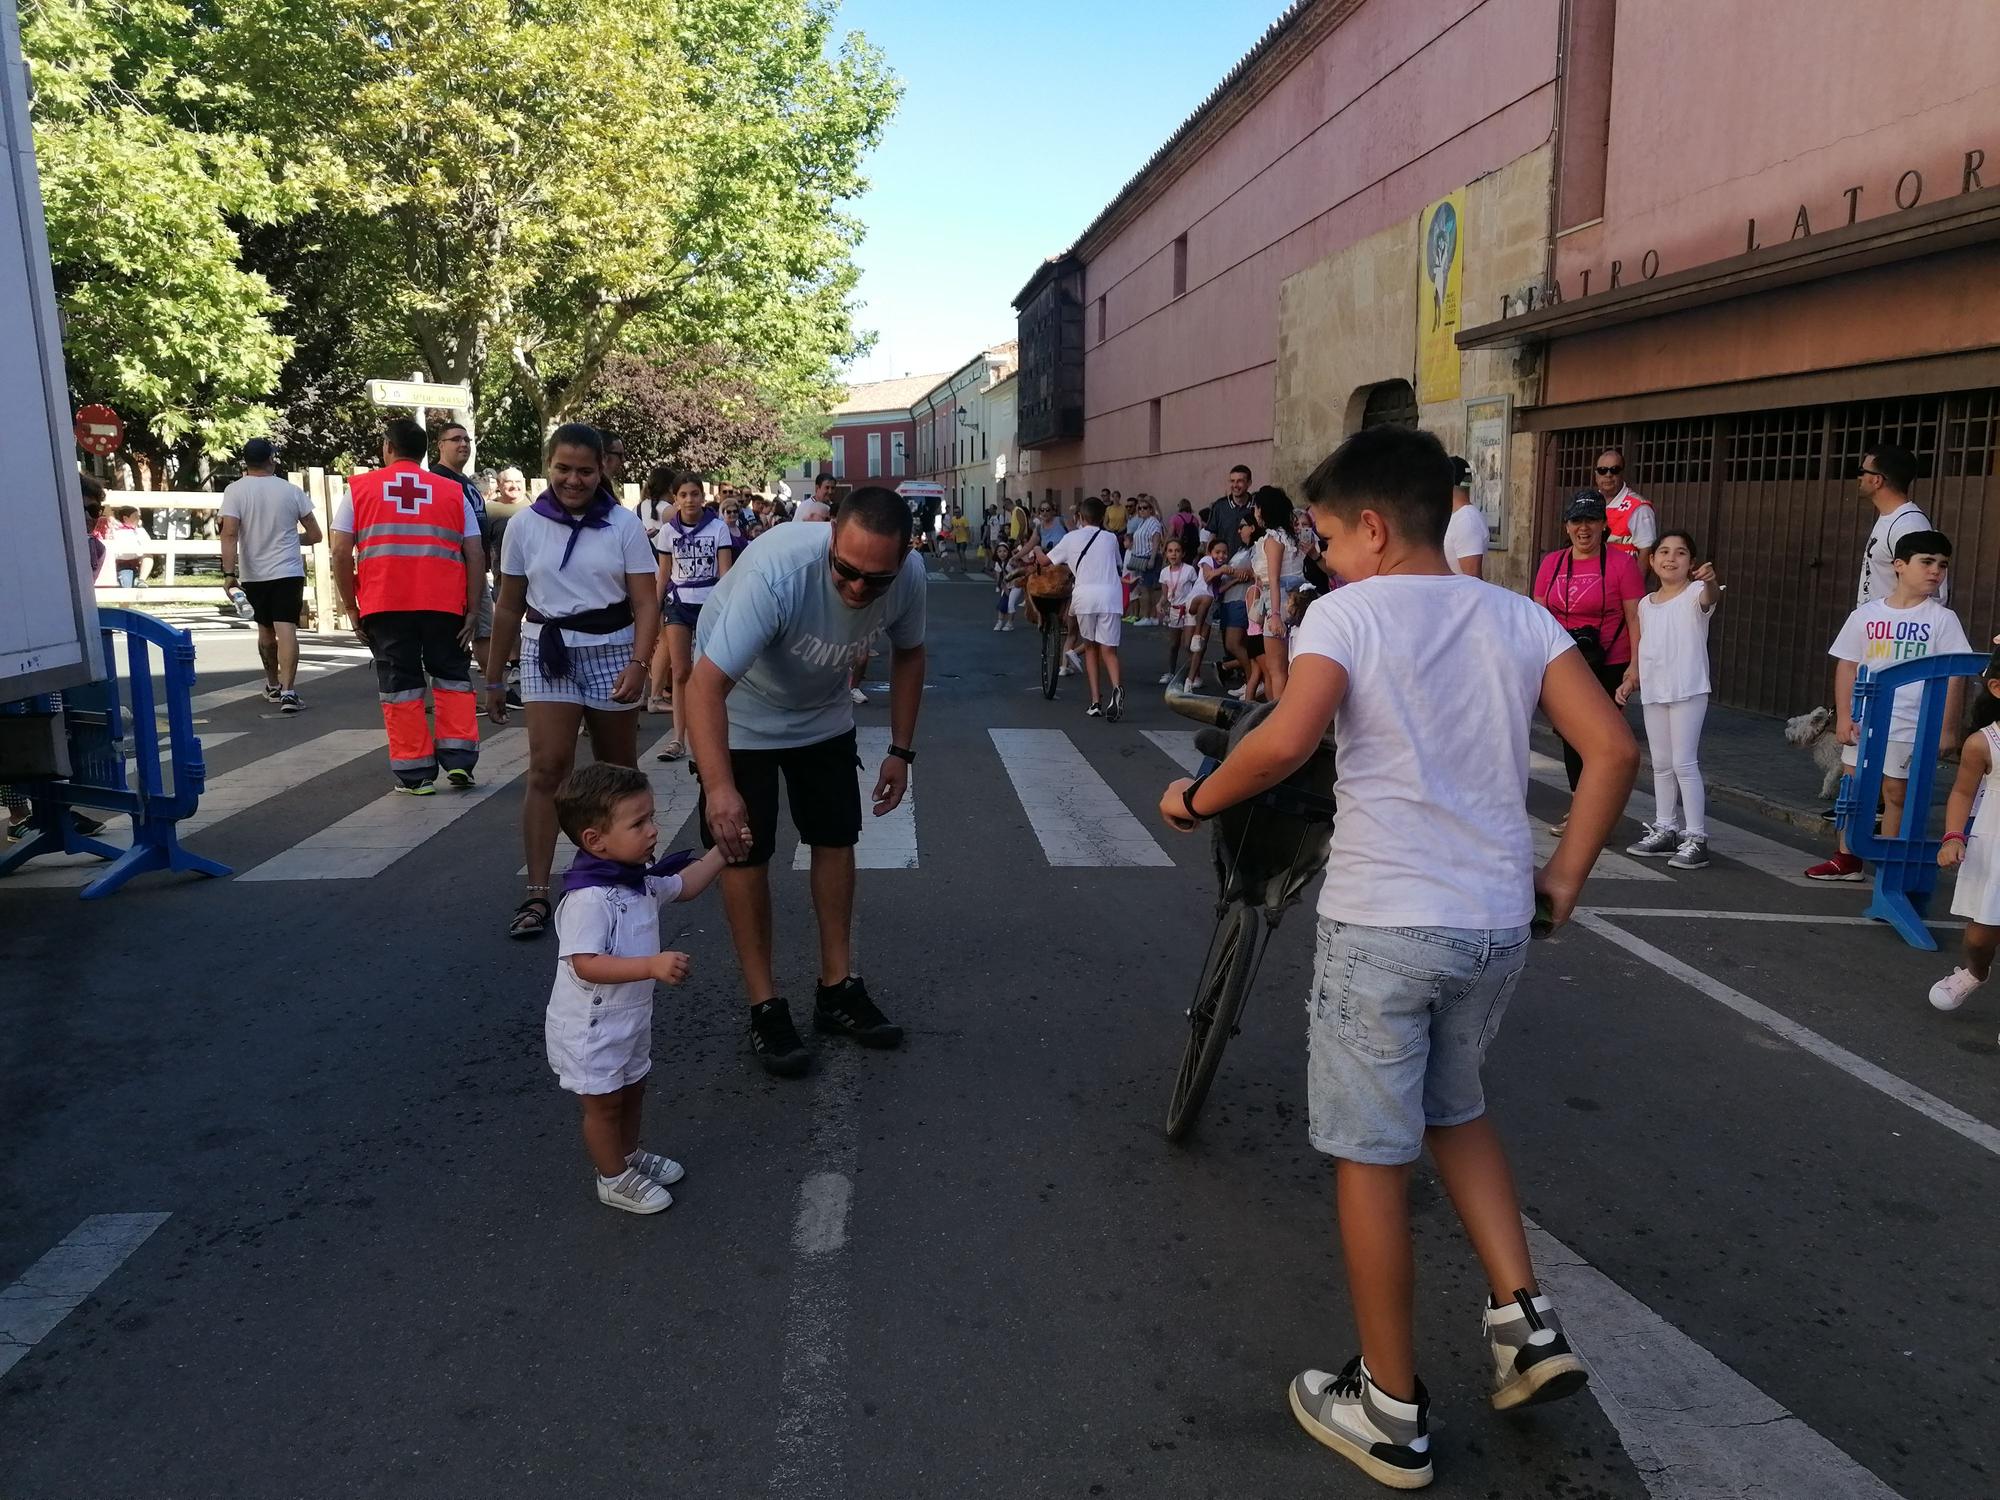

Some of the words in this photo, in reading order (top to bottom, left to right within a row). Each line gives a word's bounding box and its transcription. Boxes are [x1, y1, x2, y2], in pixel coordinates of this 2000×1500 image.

[1500, 250, 1660, 320] TEATRO
[790, 624, 885, 667] CONVER
[1866, 621, 1931, 642] COLORS
[1866, 640, 1928, 660] UNITED
